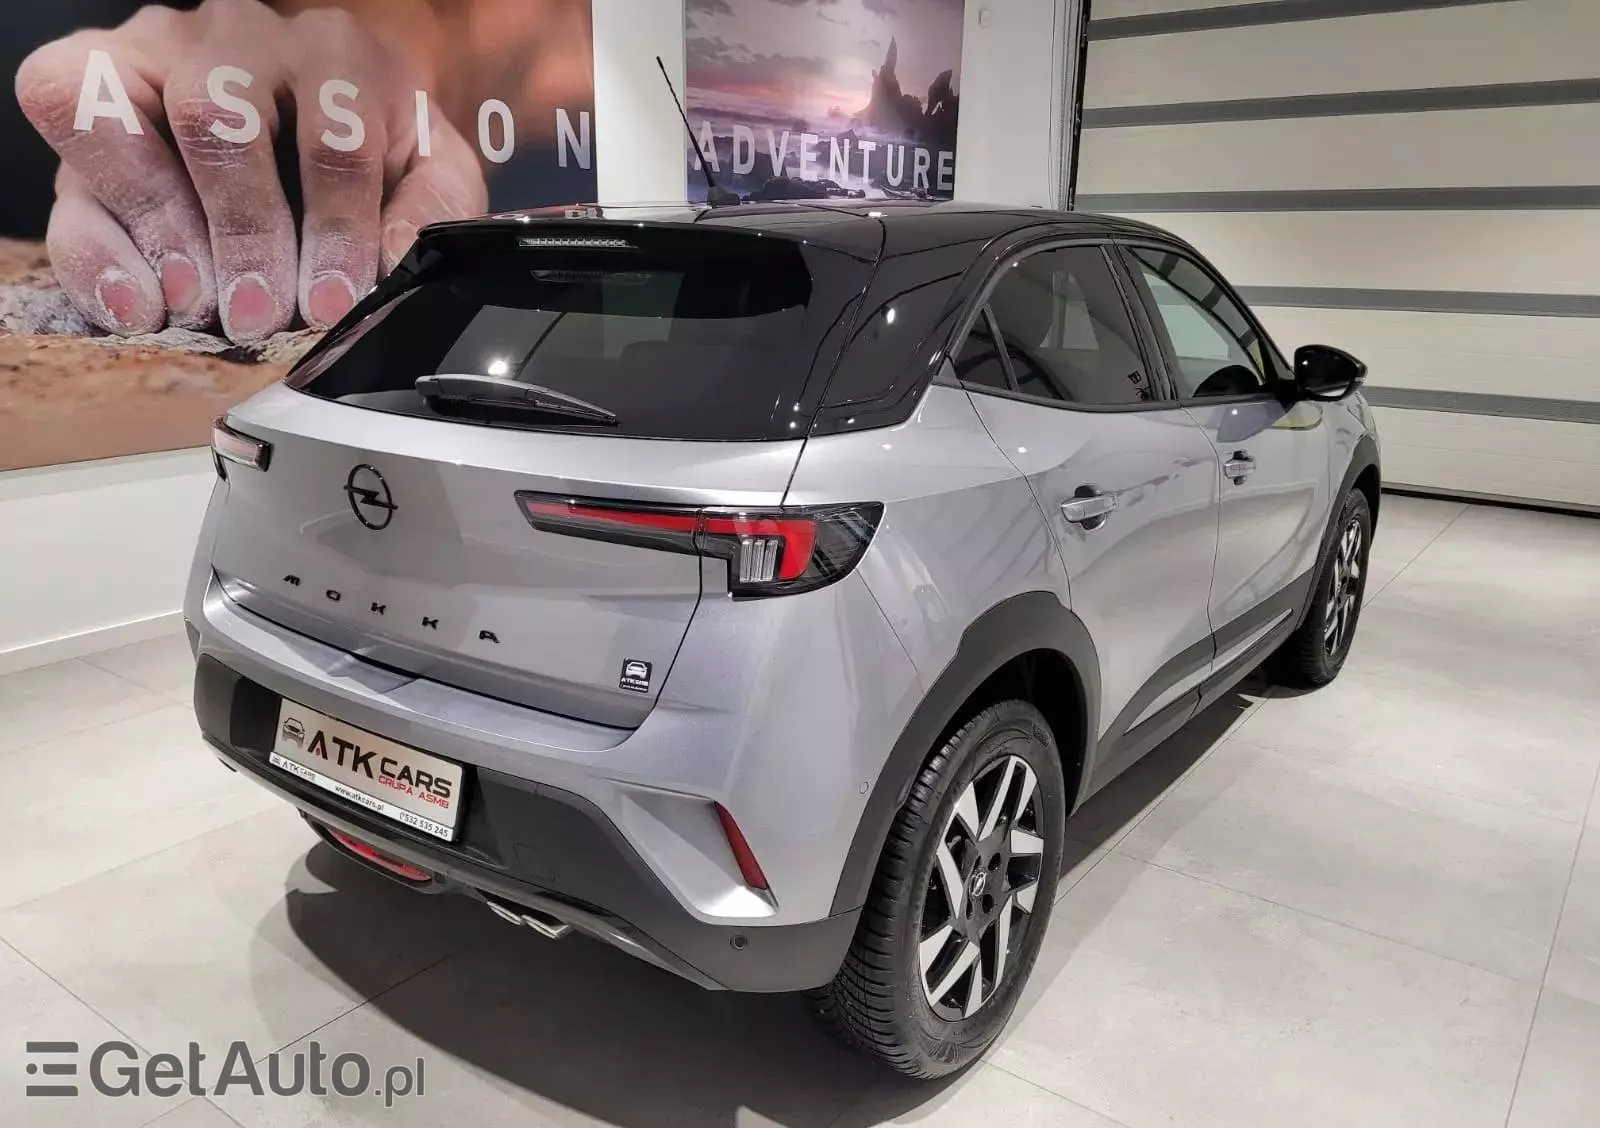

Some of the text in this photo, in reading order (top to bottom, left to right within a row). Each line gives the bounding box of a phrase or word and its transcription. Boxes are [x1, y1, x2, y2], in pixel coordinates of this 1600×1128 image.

[72, 50, 591, 170] ASSION
[693, 120, 954, 191] ADVENTURE
[283, 574, 500, 643] MOKKA
[335, 785, 384, 811] www.atkcars.pl
[378, 775, 449, 809] GRUPA ASMB
[434, 825, 448, 837] 245
